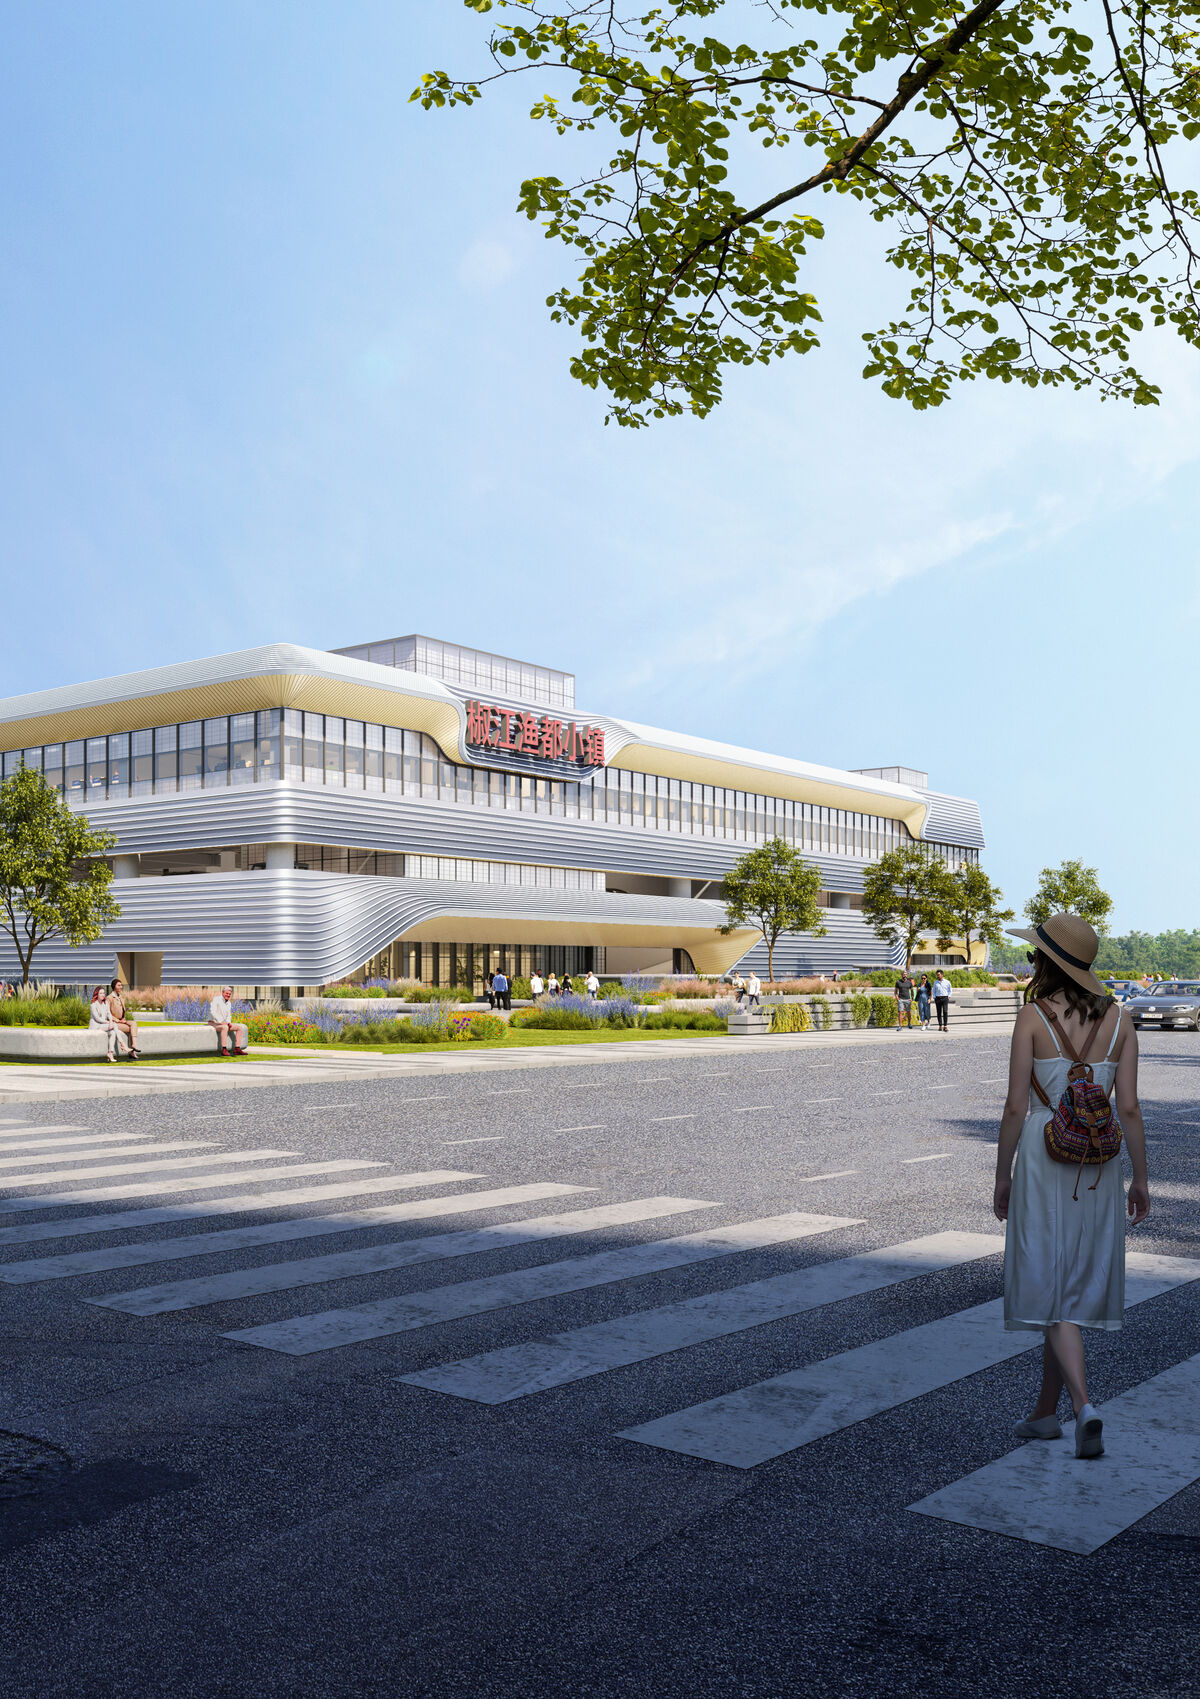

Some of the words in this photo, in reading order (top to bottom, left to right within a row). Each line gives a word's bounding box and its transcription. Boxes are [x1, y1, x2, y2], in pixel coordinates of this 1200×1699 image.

[465, 700, 606, 767] 椒江渔都小镇
